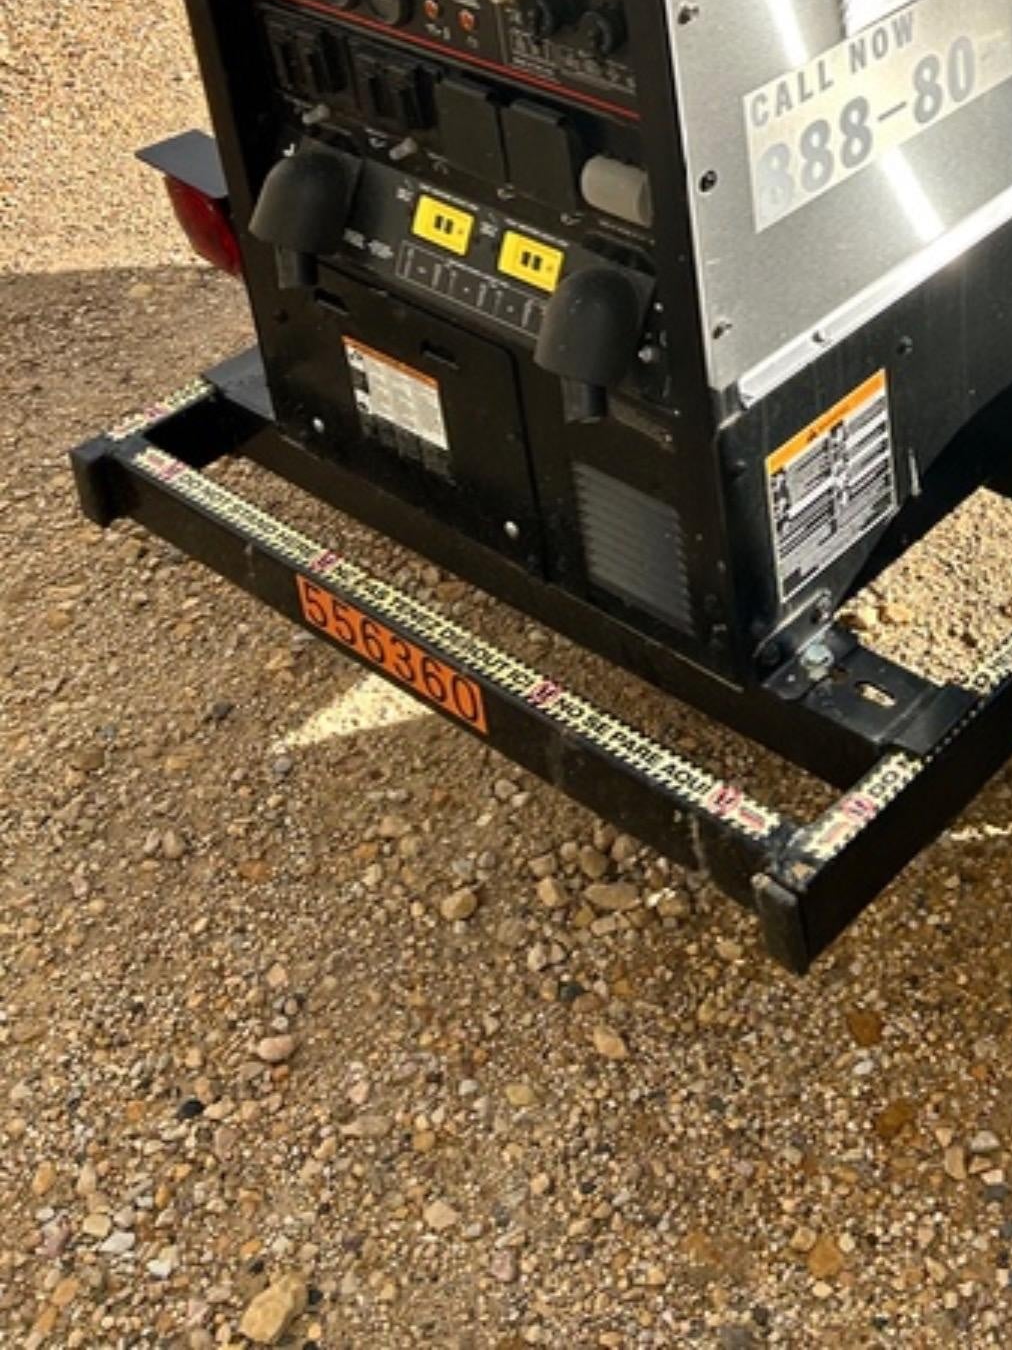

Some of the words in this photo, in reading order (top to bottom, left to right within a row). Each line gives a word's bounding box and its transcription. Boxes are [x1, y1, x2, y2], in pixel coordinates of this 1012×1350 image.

[752, 60, 834, 127] CALL
[850, 12, 913, 74] NOW
[303, 580, 481, 722] 556360
[554, 695, 584, 720] NO
[582, 712, 611, 736] SE
[608, 728, 663, 768] PARE
